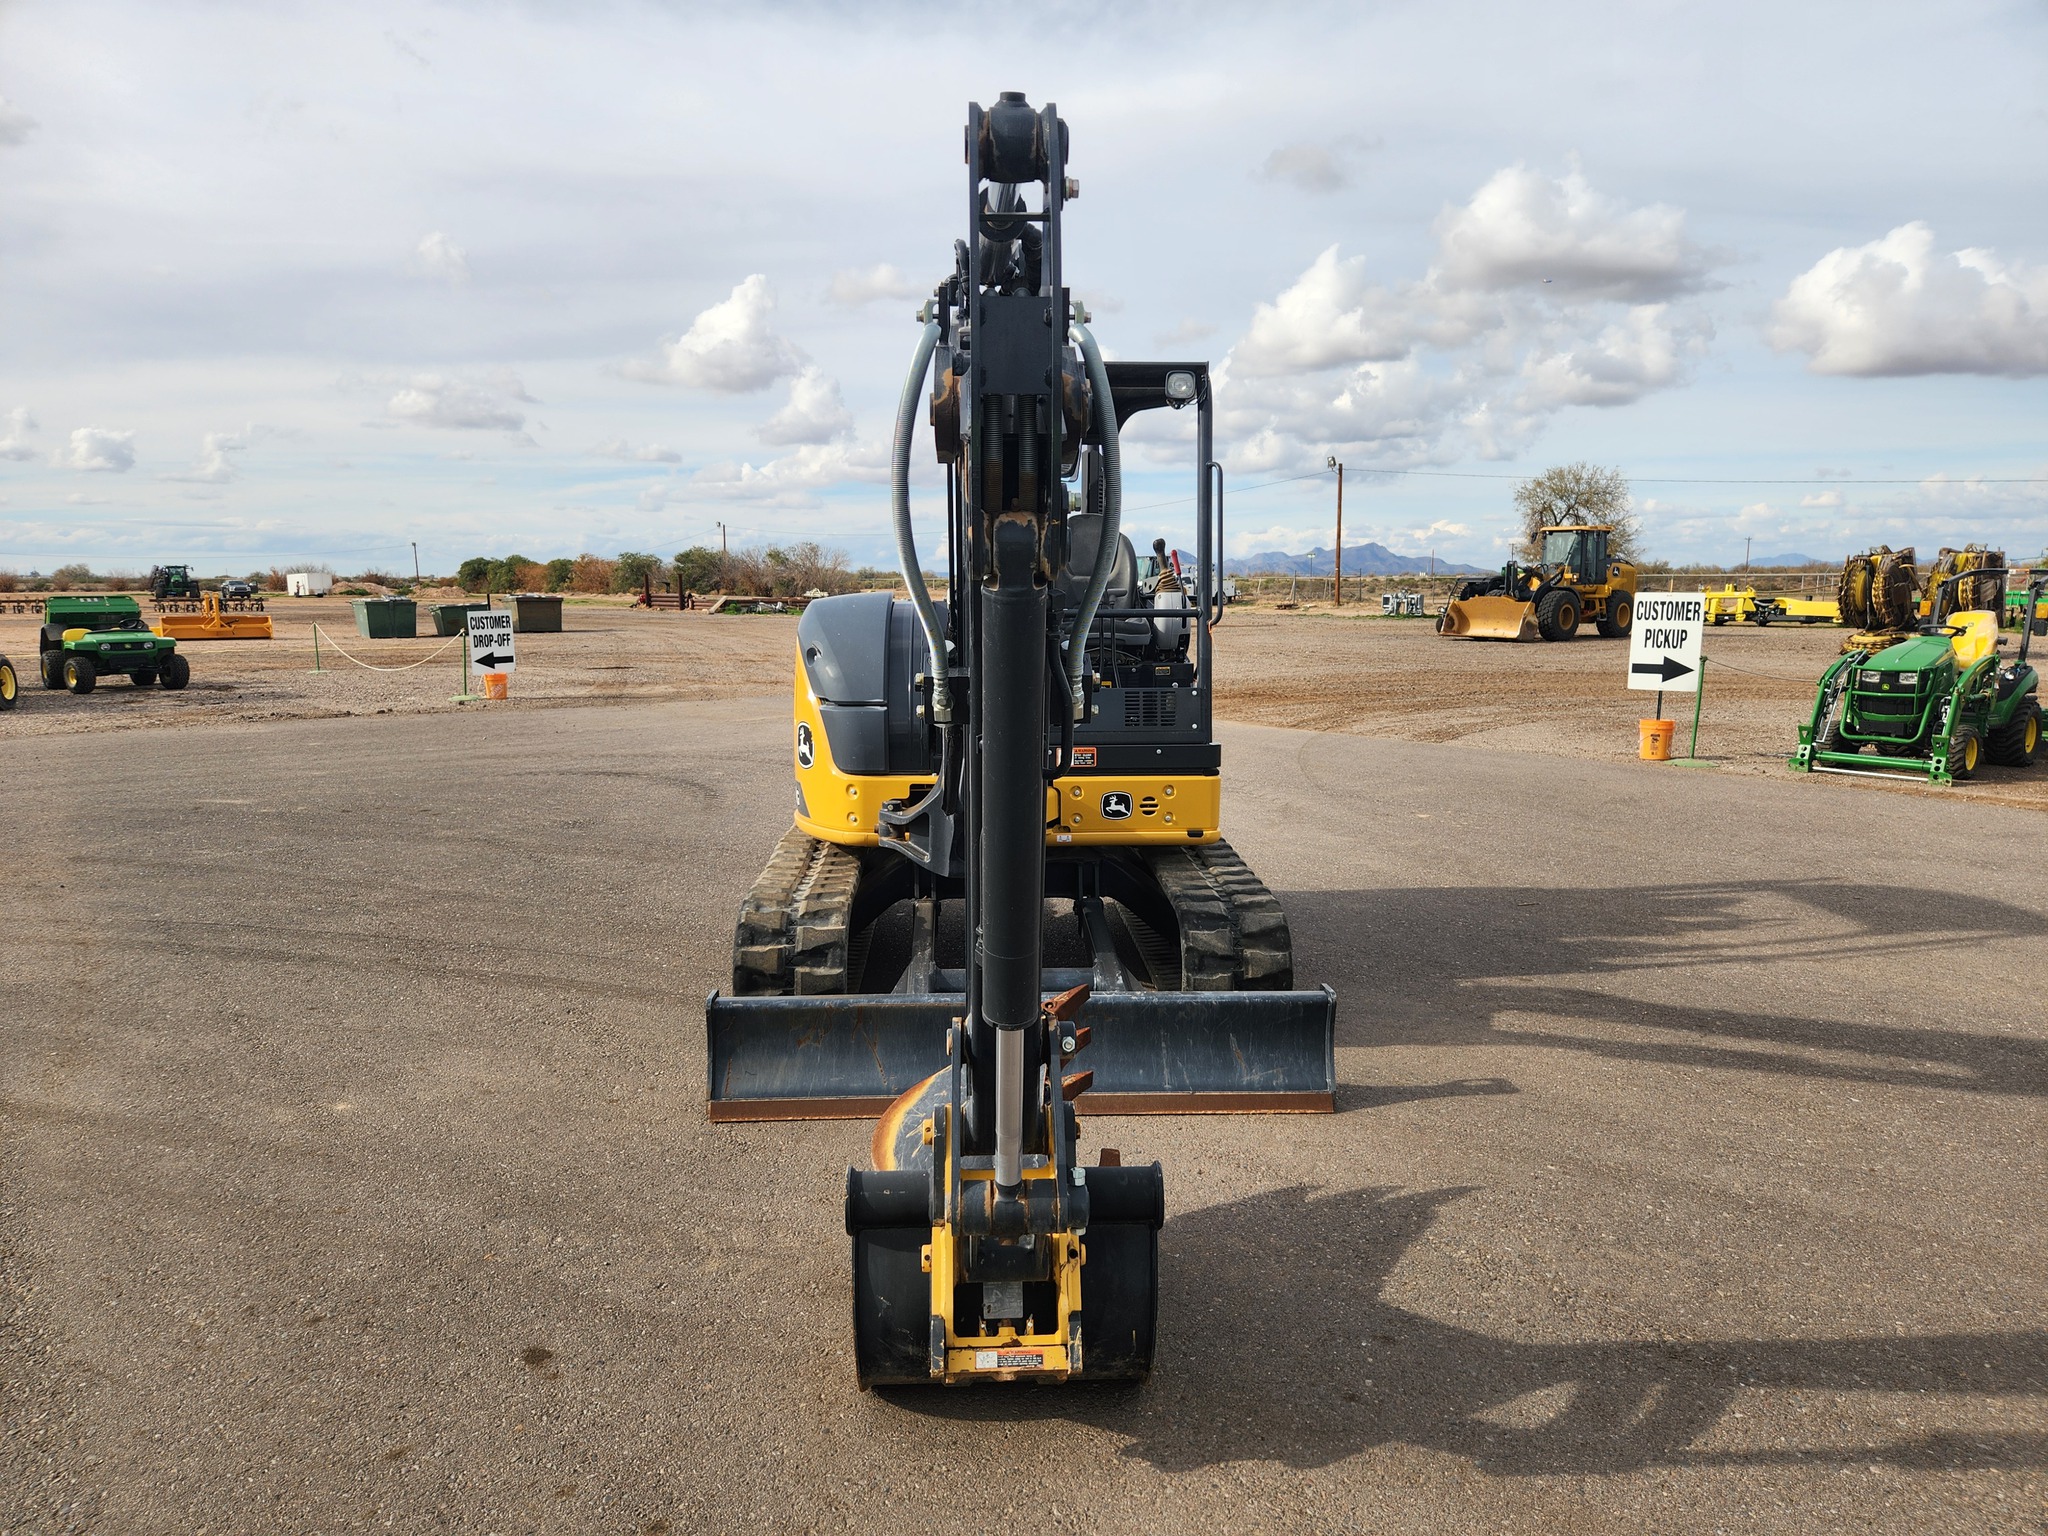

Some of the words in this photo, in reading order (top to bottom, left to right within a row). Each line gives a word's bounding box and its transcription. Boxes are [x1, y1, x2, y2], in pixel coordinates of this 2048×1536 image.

[1636, 601, 1701, 621] CUSTOMER
[470, 615, 511, 630] CUSTOMER
[473, 633, 511, 648] DROP-OFF
[1644, 629, 1688, 649] PICKUP
